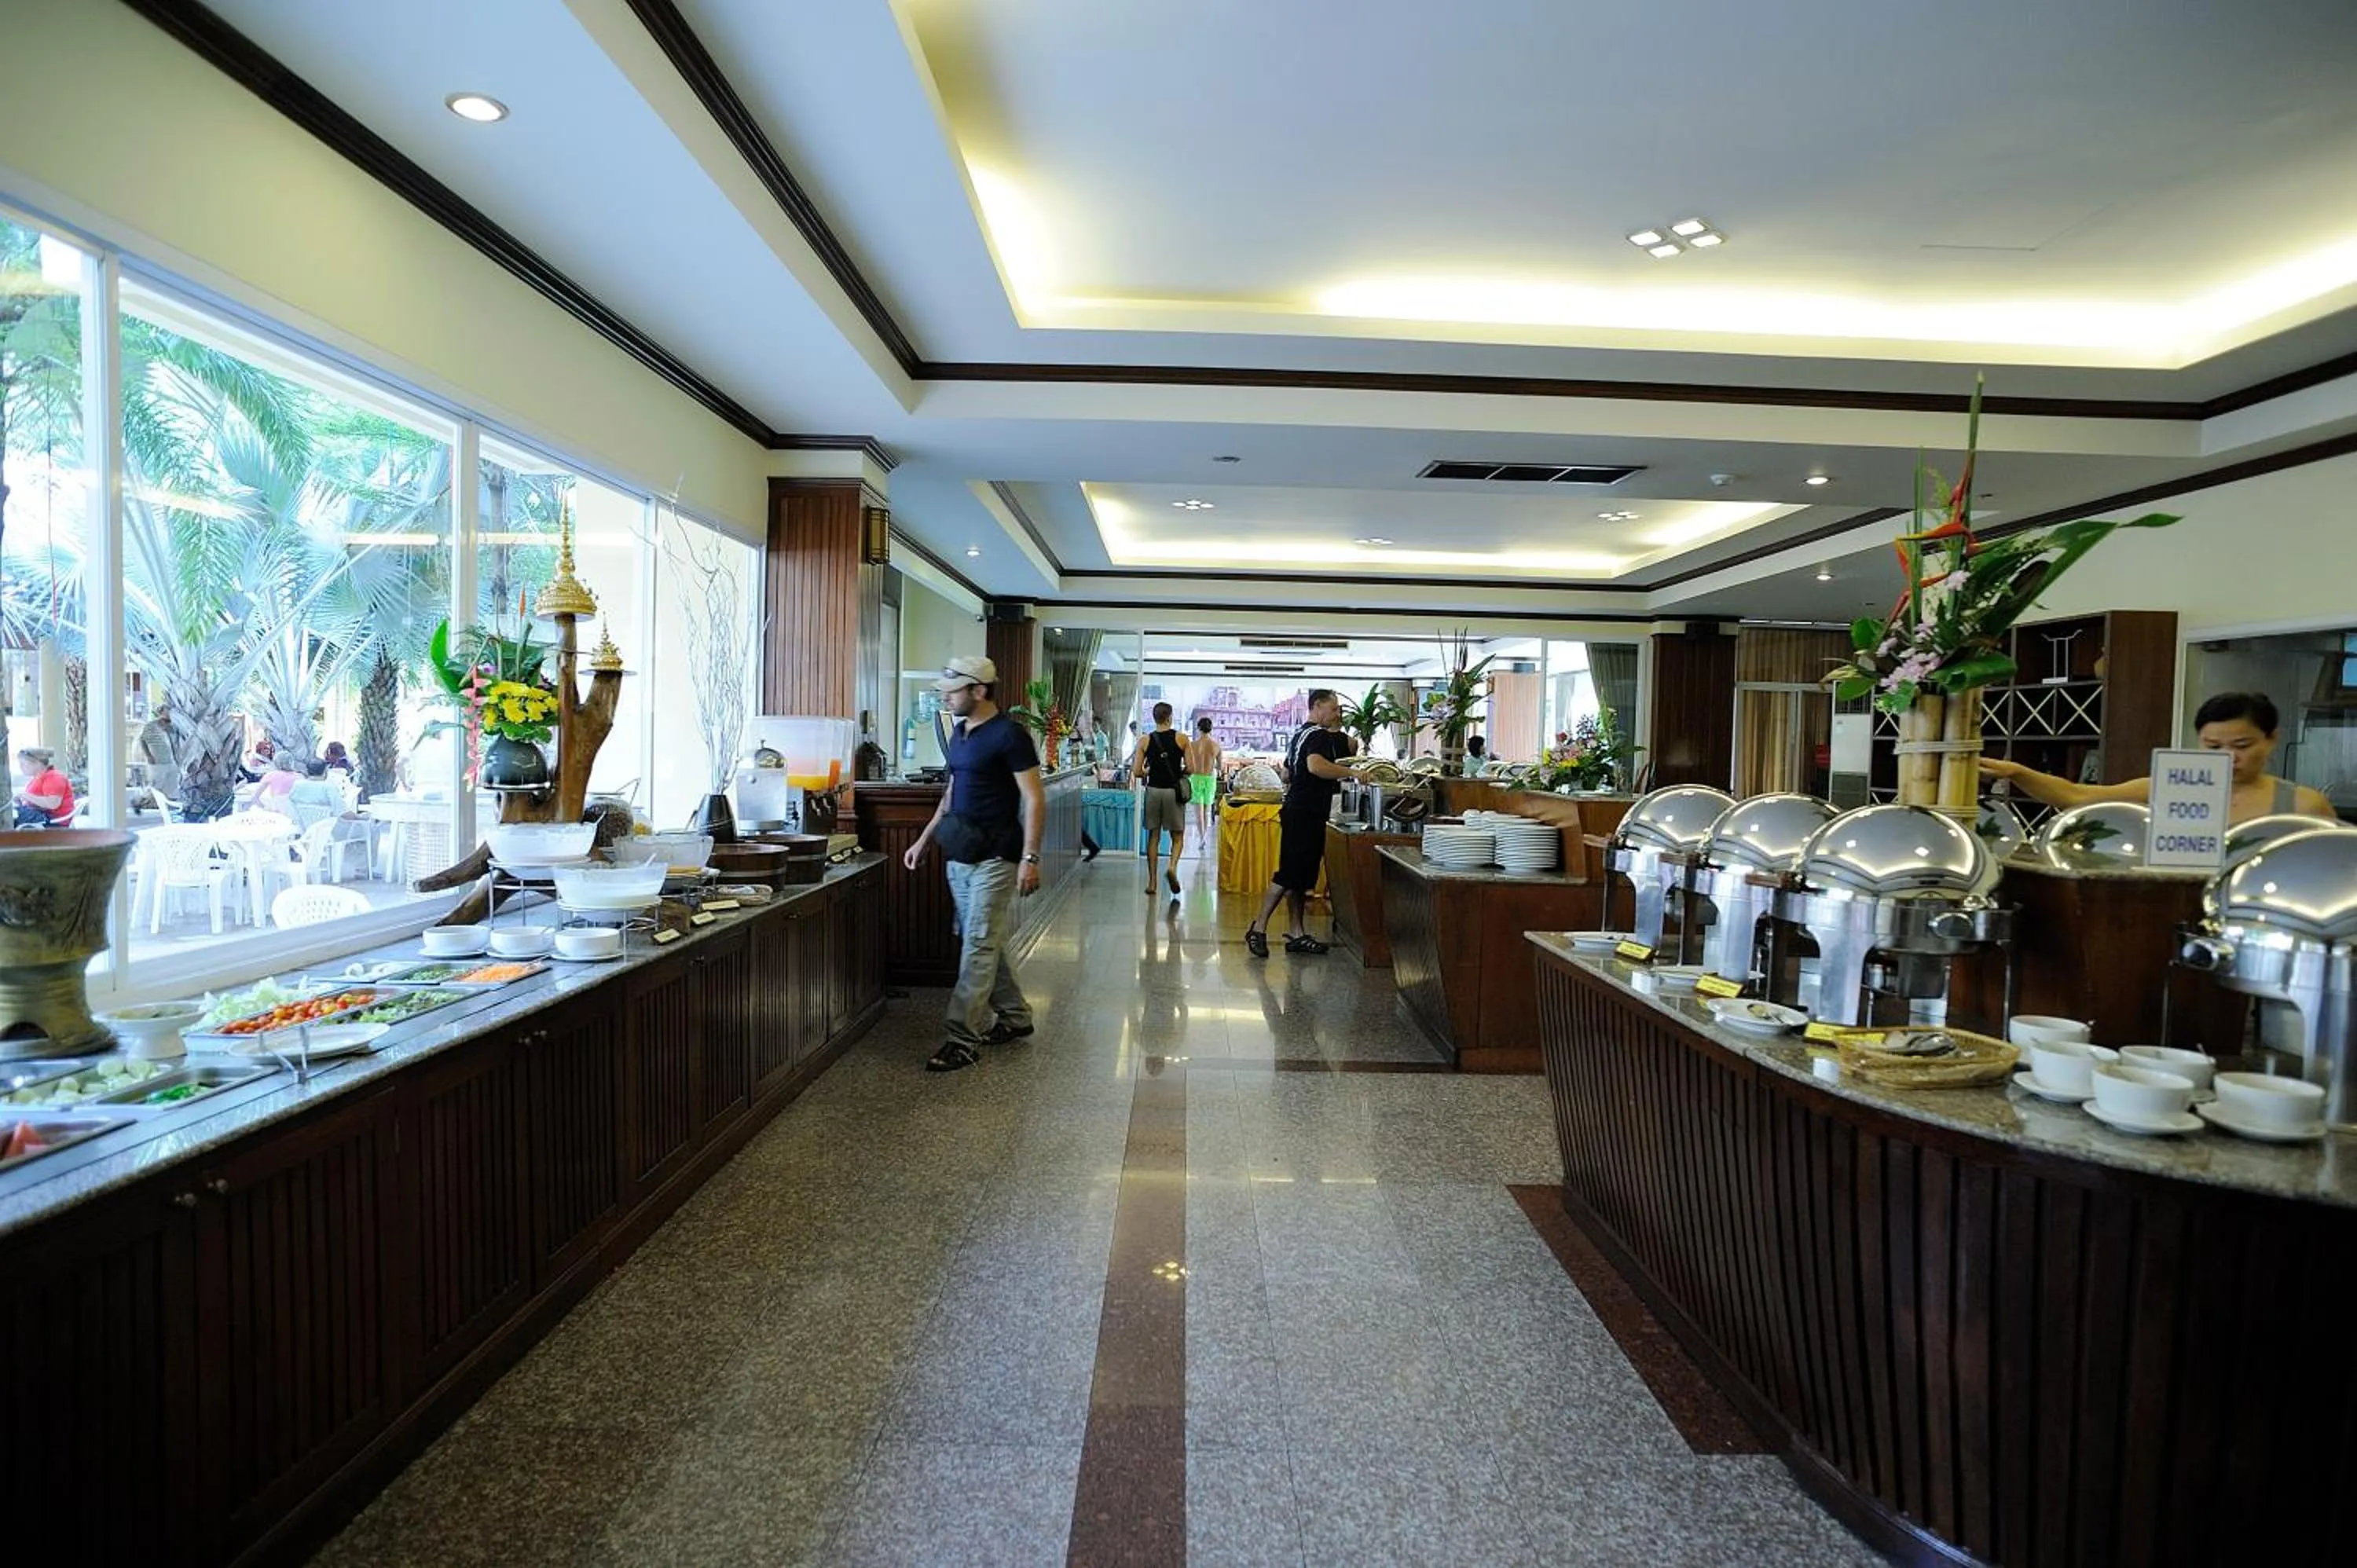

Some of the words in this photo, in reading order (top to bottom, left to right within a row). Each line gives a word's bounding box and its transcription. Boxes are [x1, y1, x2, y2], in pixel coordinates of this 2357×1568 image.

[2168, 768, 2214, 786] HALAL
[2168, 802, 2210, 819] FOOD
[2156, 835, 2217, 852] CORNER
